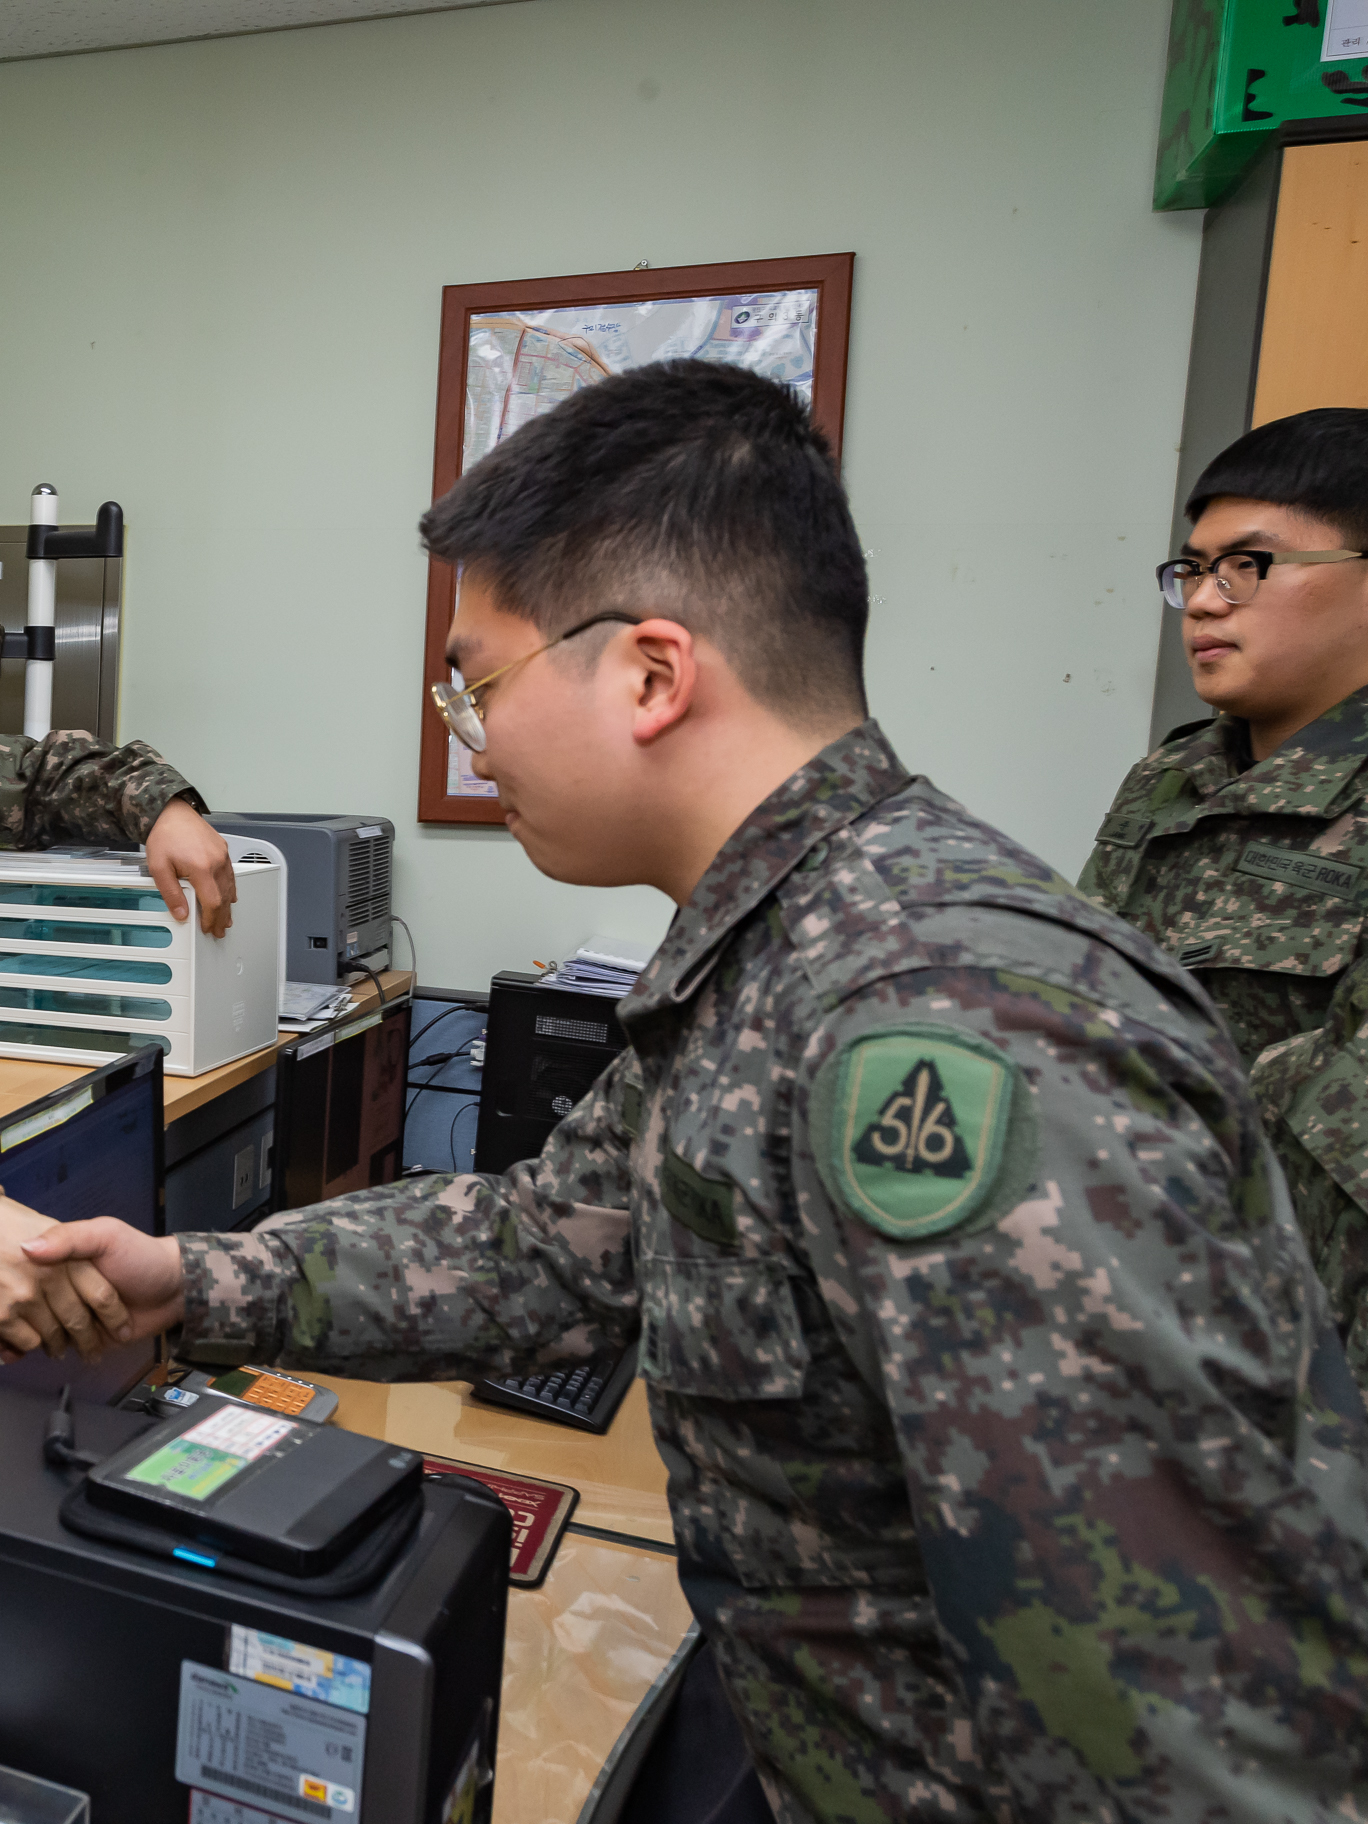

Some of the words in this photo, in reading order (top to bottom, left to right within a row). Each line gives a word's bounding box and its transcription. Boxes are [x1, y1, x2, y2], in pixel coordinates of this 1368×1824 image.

[1341, 37, 1361, 48] 관리
[1243, 849, 1291, 873] 대한민국
[1291, 860, 1317, 879] 육군
[1317, 866, 1353, 889] ROKA
[870, 1096, 955, 1163] 56
